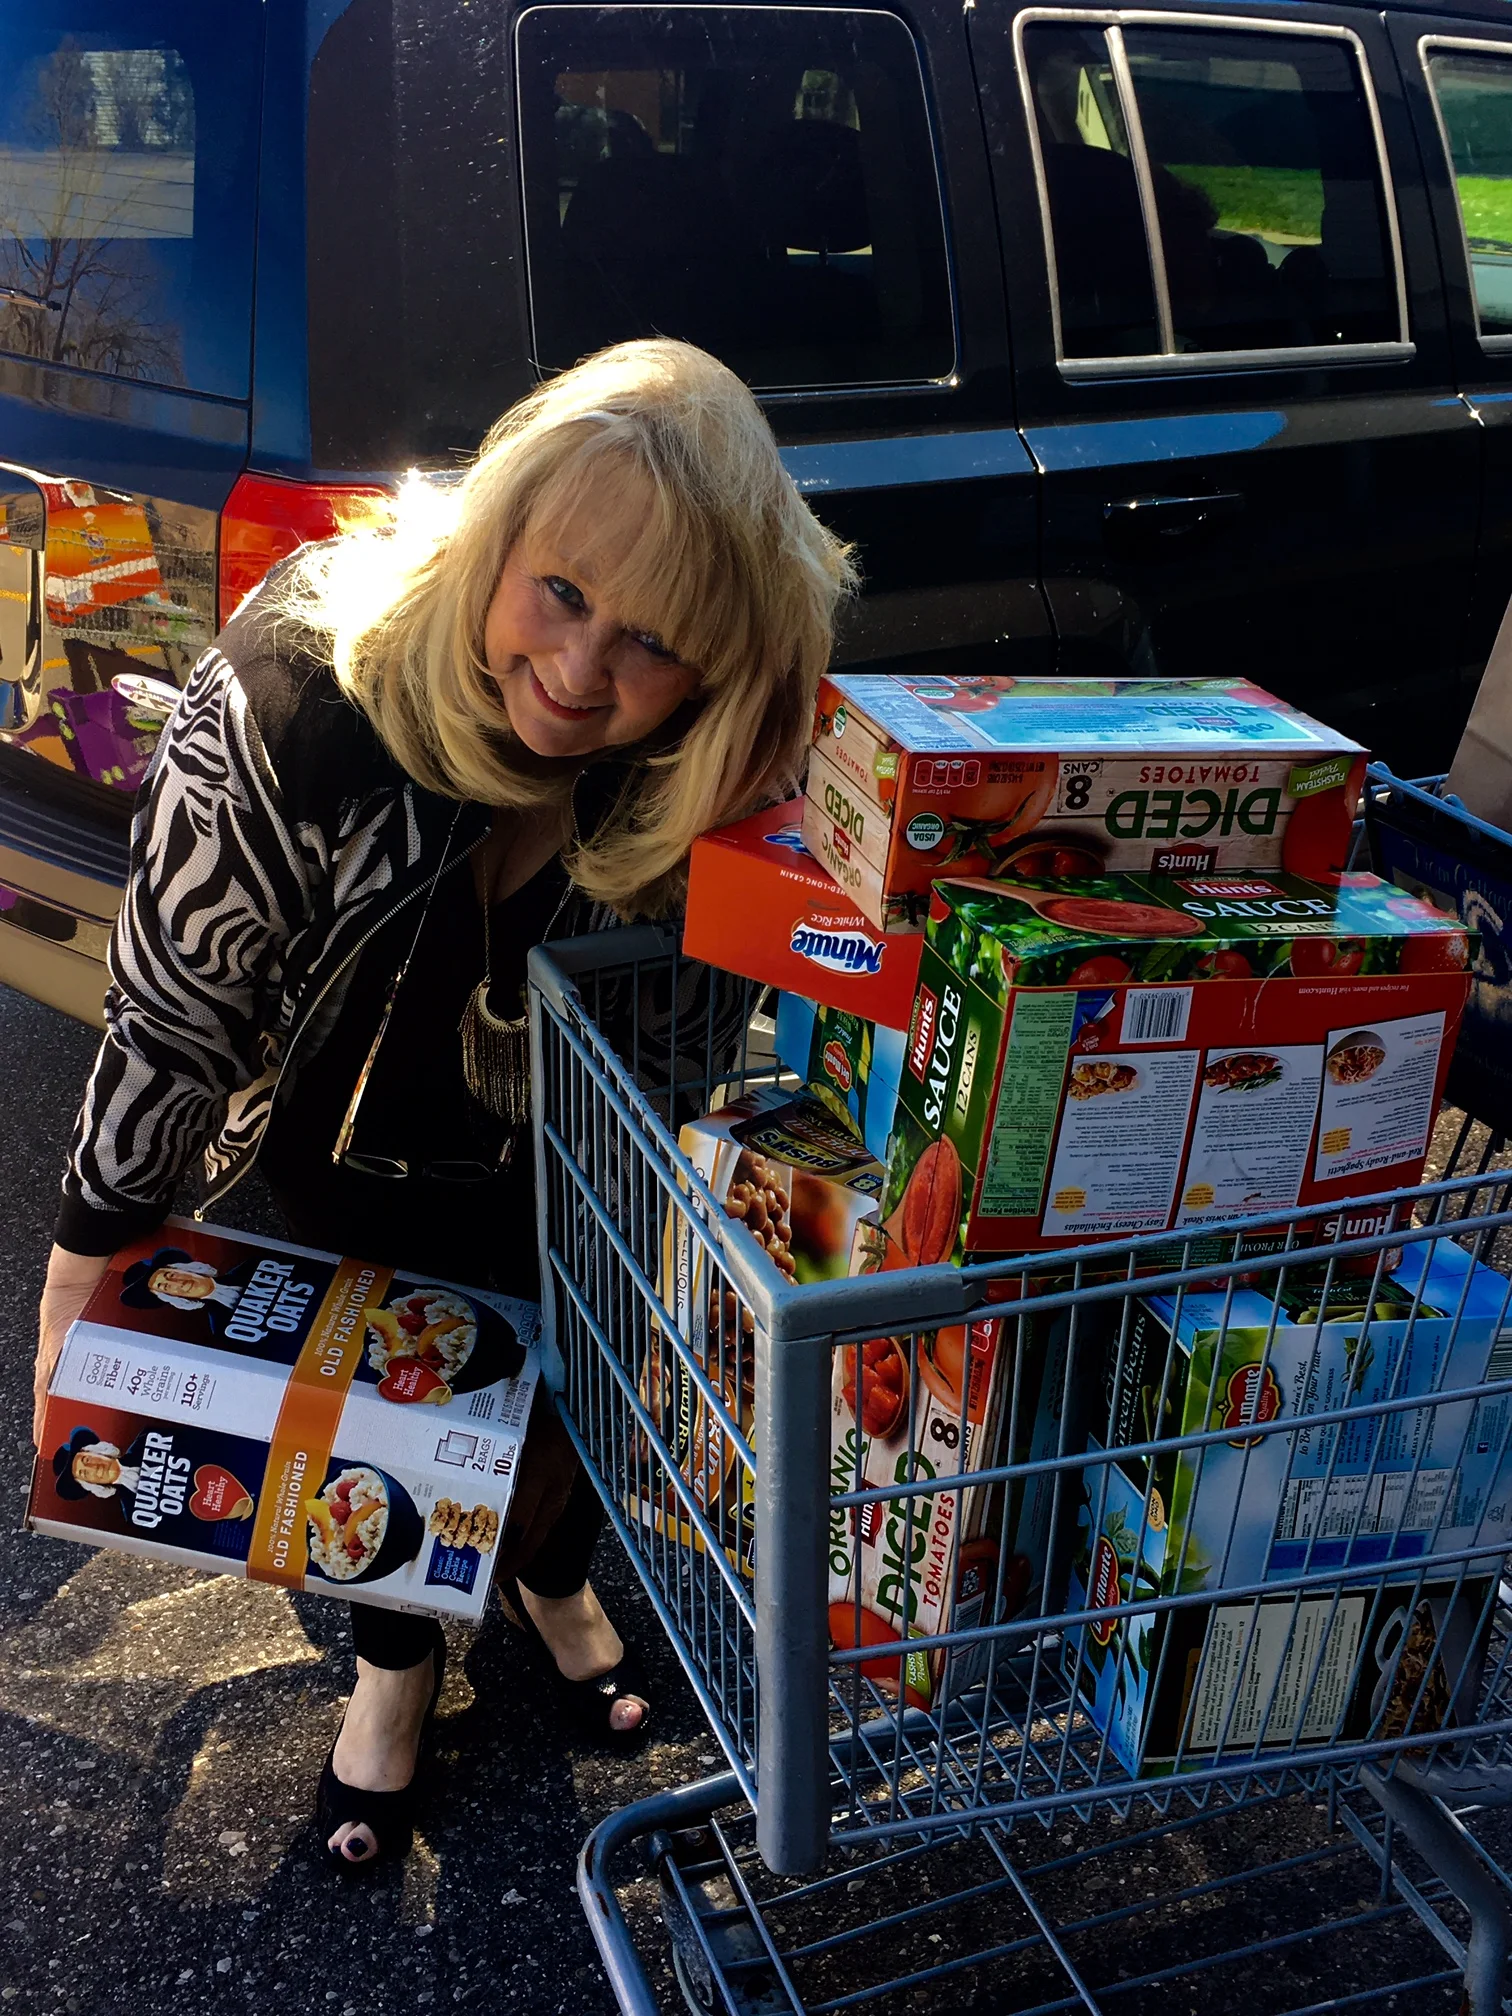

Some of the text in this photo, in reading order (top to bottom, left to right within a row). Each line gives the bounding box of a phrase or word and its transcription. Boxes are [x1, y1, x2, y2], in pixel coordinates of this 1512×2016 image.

[1145, 706, 1258, 717] DICED
[1178, 723, 1275, 735] ORGANIC
[836, 746, 868, 782] TOMATOES
[1063, 762, 1099, 775] CANS
[1139, 764, 1260, 784] TOMATOES
[1065, 775, 1093, 810] 8
[825, 784, 865, 844] DICED
[912, 822, 940, 831] ORGANIC
[1104, 788, 1283, 839] DICED
[913, 832, 936, 842] USDA
[780, 869, 803, 883] GRAIN
[822, 833, 861, 888] ORGANIC
[1192, 881, 1271, 895] Hunt's
[810, 913, 865, 927] White Rice
[1181, 899, 1341, 918] SAUCE
[1246, 920, 1342, 934] 12 CANS
[791, 929, 886, 973] Minute
[913, 998, 933, 1071] Hunt's
[825, 1051, 850, 1083] Del Monte
[924, 984, 961, 1130] SAUCE
[957, 1030, 977, 1116] 12 CANS
[757, 1132, 843, 1168] BUSH'S
[1327, 1146, 1423, 1176] Red-and-Ready Spaghetti
[853, 1178, 877, 1191] 8
[982, 1207, 1002, 1215] Facts
[1064, 1219, 1165, 1233] Easy Cheesy Enchiladas
[1183, 1214, 1226, 1225] Steak Swiss
[1228, 1241, 1275, 1253] PROMIE
[1276, 1240, 1300, 1251] OR
[224, 1260, 295, 1343] QUAKER
[266, 1281, 315, 1332] OATS
[314, 1341, 325, 1357] 100%
[321, 1312, 336, 1341] Natural
[320, 1269, 376, 1376] OLD FASHIONED
[1123, 1313, 1146, 1385] Beans
[86, 1354, 104, 1385] Good
[104, 1358, 122, 1389] Fiber
[127, 1368, 147, 1395] 40g
[141, 1365, 158, 1396] Whole
[151, 1365, 171, 1402] Grains
[393, 1369, 409, 1391] Heart
[403, 1366, 424, 1396] Healthy
[1294, 1361, 1308, 1385] Best,
[181, 1373, 198, 1407] 110+
[192, 1373, 210, 1411] Servings
[1258, 1390, 1272, 1420] Quality
[1299, 1446, 1308, 1455] to
[1306, 1375, 1319, 1401] Your
[930, 1418, 959, 1450] 8
[472, 1438, 492, 1472] 2 BAGS
[493, 1443, 517, 1476] 10 lbs.
[131, 1432, 174, 1528] QUAKER
[160, 1456, 191, 1516] OATS
[202, 1481, 215, 1506] Heart
[212, 1476, 228, 1512] Healthy
[267, 1461, 291, 1553] 100% Natural Whole Grain
[273, 1451, 307, 1568] OLD FASHIONED
[877, 1452, 937, 1624] DICED
[923, 1493, 955, 1609] TOMATOES
[434, 1556, 442, 1578] Classic
[441, 1550, 455, 1579] Oatmeal
[449, 1557, 460, 1581] Cookie
[456, 1559, 468, 1583] Recipe
[1097, 1545, 1111, 1605] Monte
